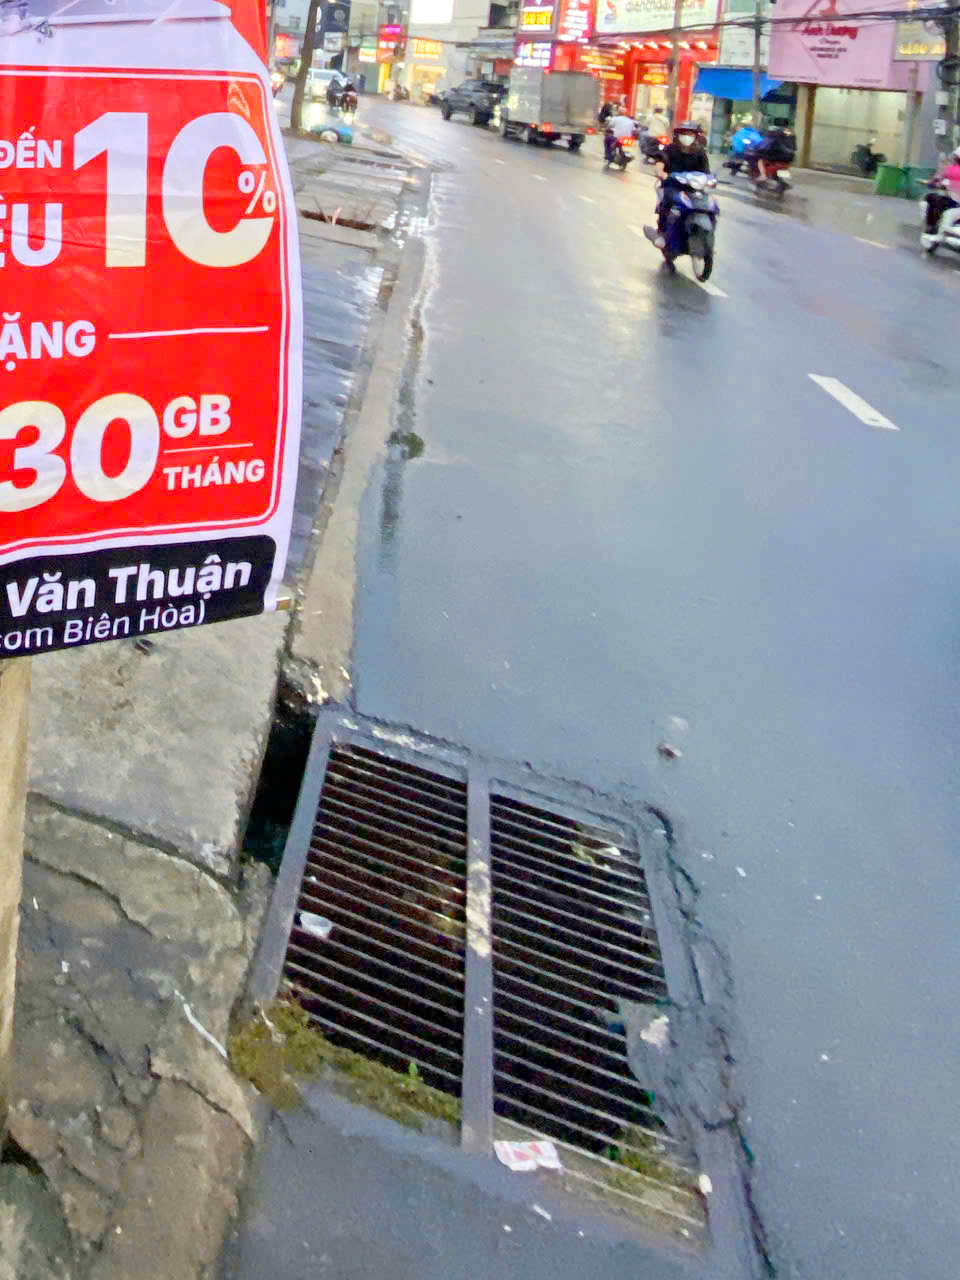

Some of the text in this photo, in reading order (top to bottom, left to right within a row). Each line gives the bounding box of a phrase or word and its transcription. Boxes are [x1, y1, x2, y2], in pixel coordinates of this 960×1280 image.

[163, 394, 232, 438] GB
[163, 458, 266, 492] THÁNG
[5, 569, 96, 619] Văn
[109, 556, 253, 609] Thuận
[62, 607, 132, 647] Biên
[139, 598, 208, 634] Hòa)
